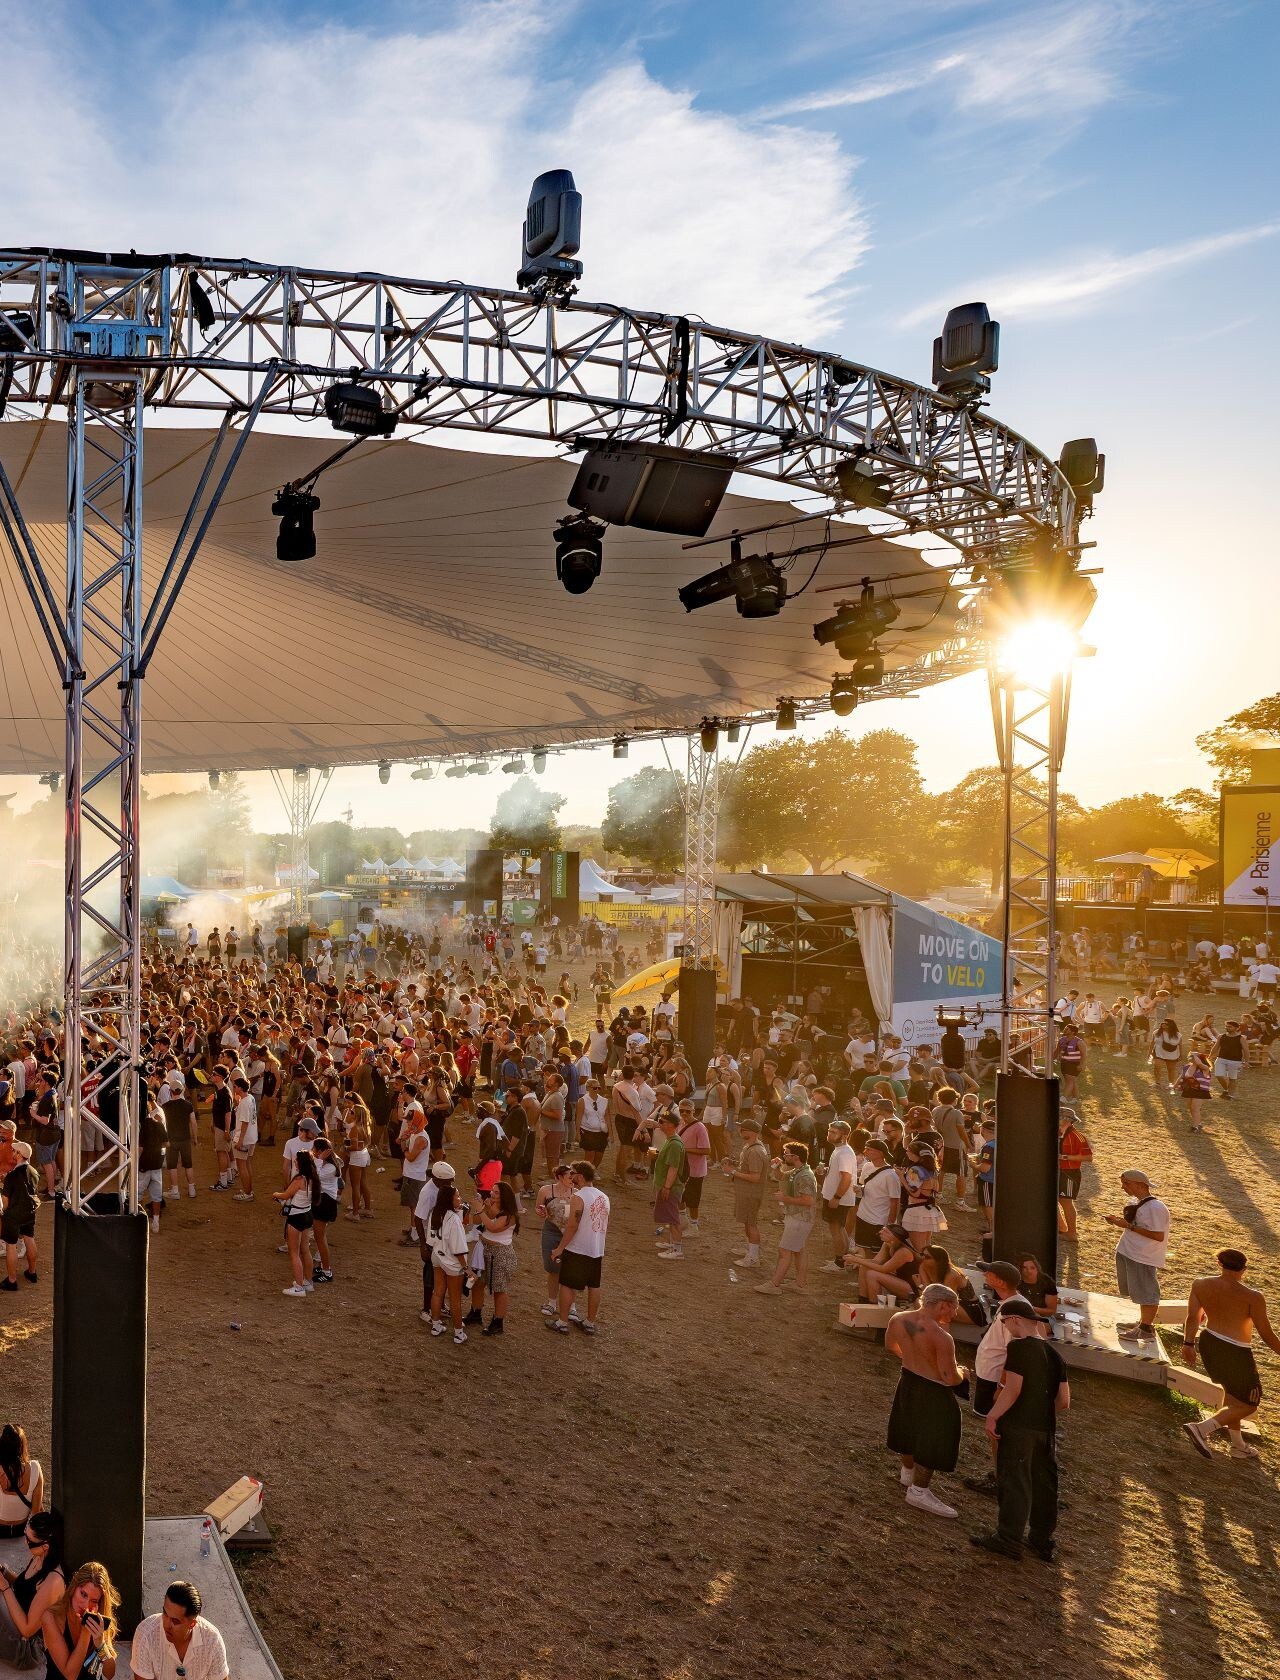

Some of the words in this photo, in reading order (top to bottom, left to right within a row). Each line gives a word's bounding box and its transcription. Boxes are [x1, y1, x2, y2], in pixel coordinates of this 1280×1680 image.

[1250, 812, 1271, 879] Parisienne
[919, 935, 965, 960] MOVE
[969, 940, 989, 961] ON
[921, 962, 943, 984] TO
[947, 964, 985, 988] VELO
